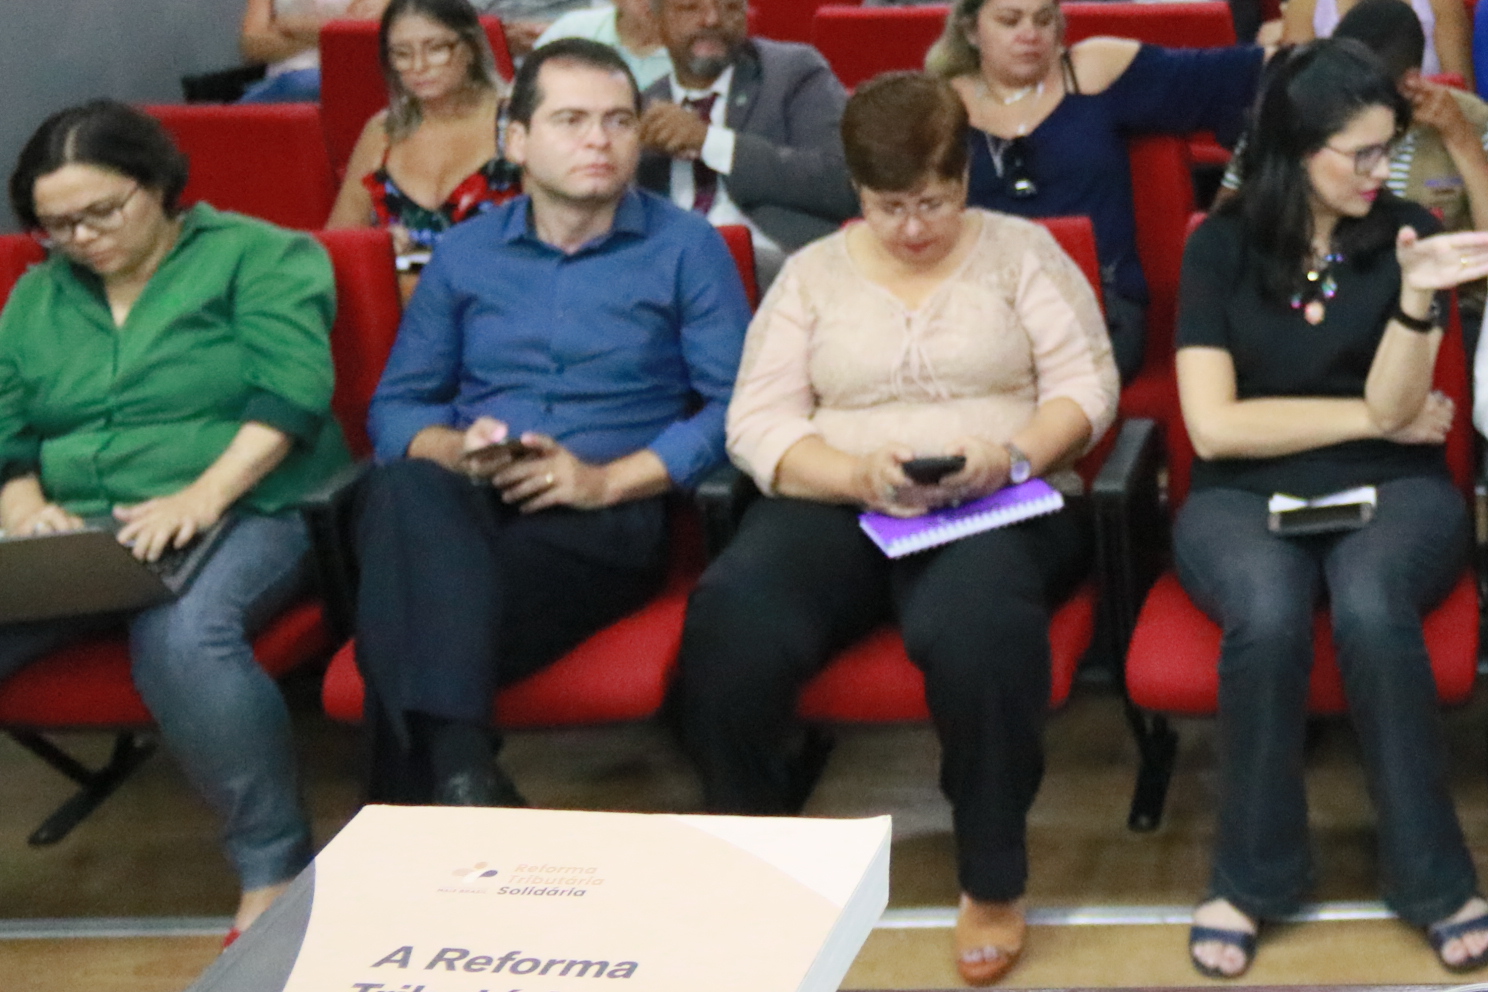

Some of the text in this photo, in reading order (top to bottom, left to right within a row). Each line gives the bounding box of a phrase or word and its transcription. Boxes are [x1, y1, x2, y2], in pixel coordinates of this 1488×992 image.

[515, 863, 598, 875] Reforma
[497, 886, 587, 897] Solidária
[370, 945, 639, 979] A Reforma
